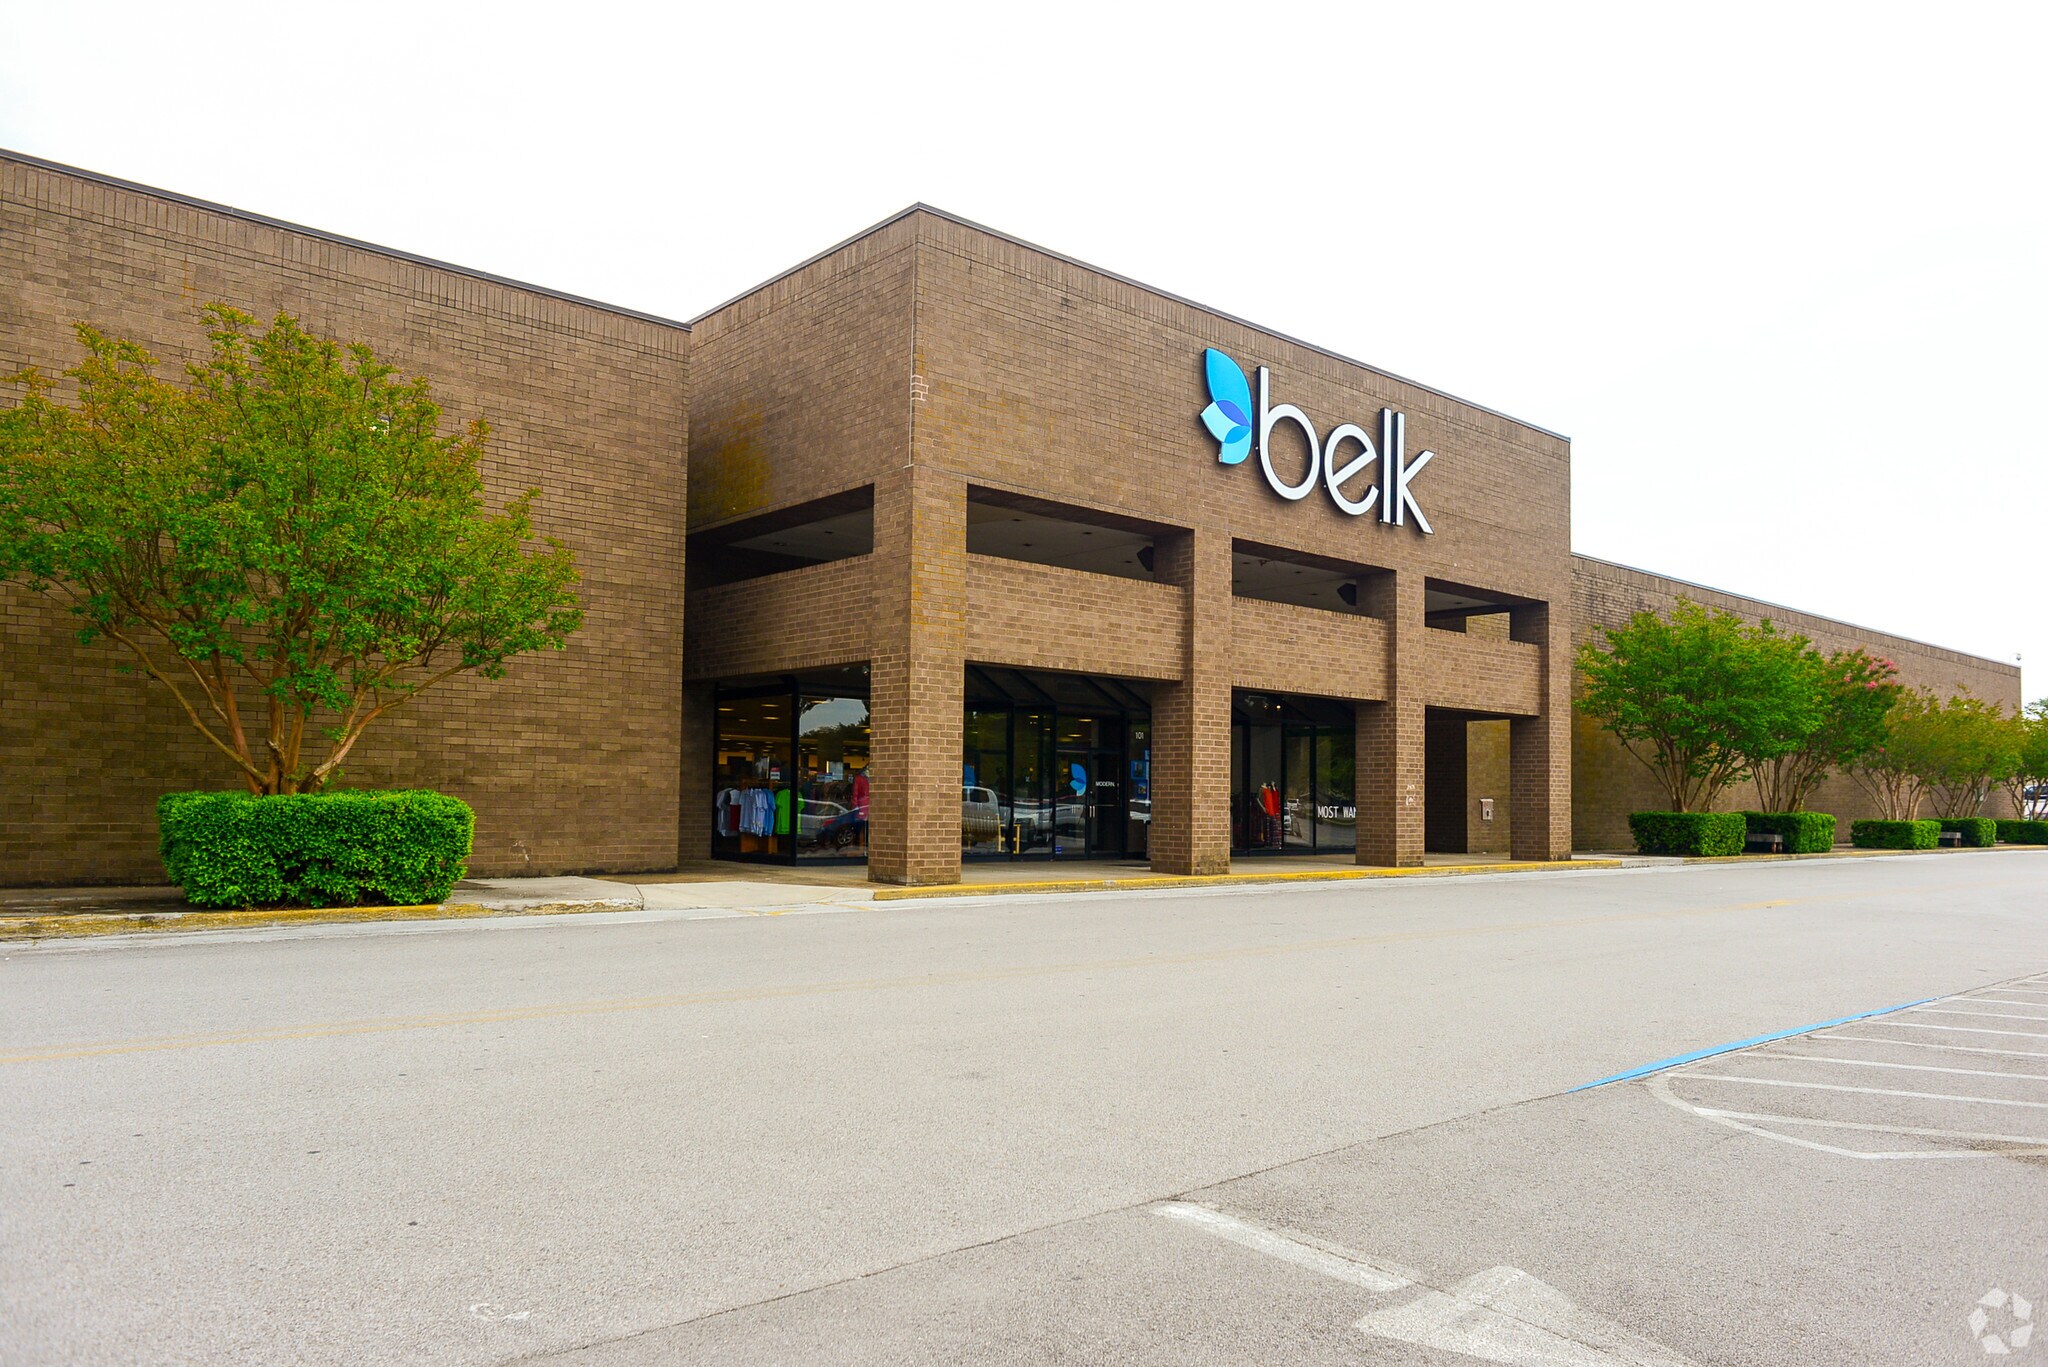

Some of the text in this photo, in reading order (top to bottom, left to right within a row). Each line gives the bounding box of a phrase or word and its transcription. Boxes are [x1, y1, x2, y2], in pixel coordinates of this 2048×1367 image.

[1256, 365, 1435, 535] belk
[1135, 731, 1144, 740] 101
[1317, 805, 1339, 819] MOST
